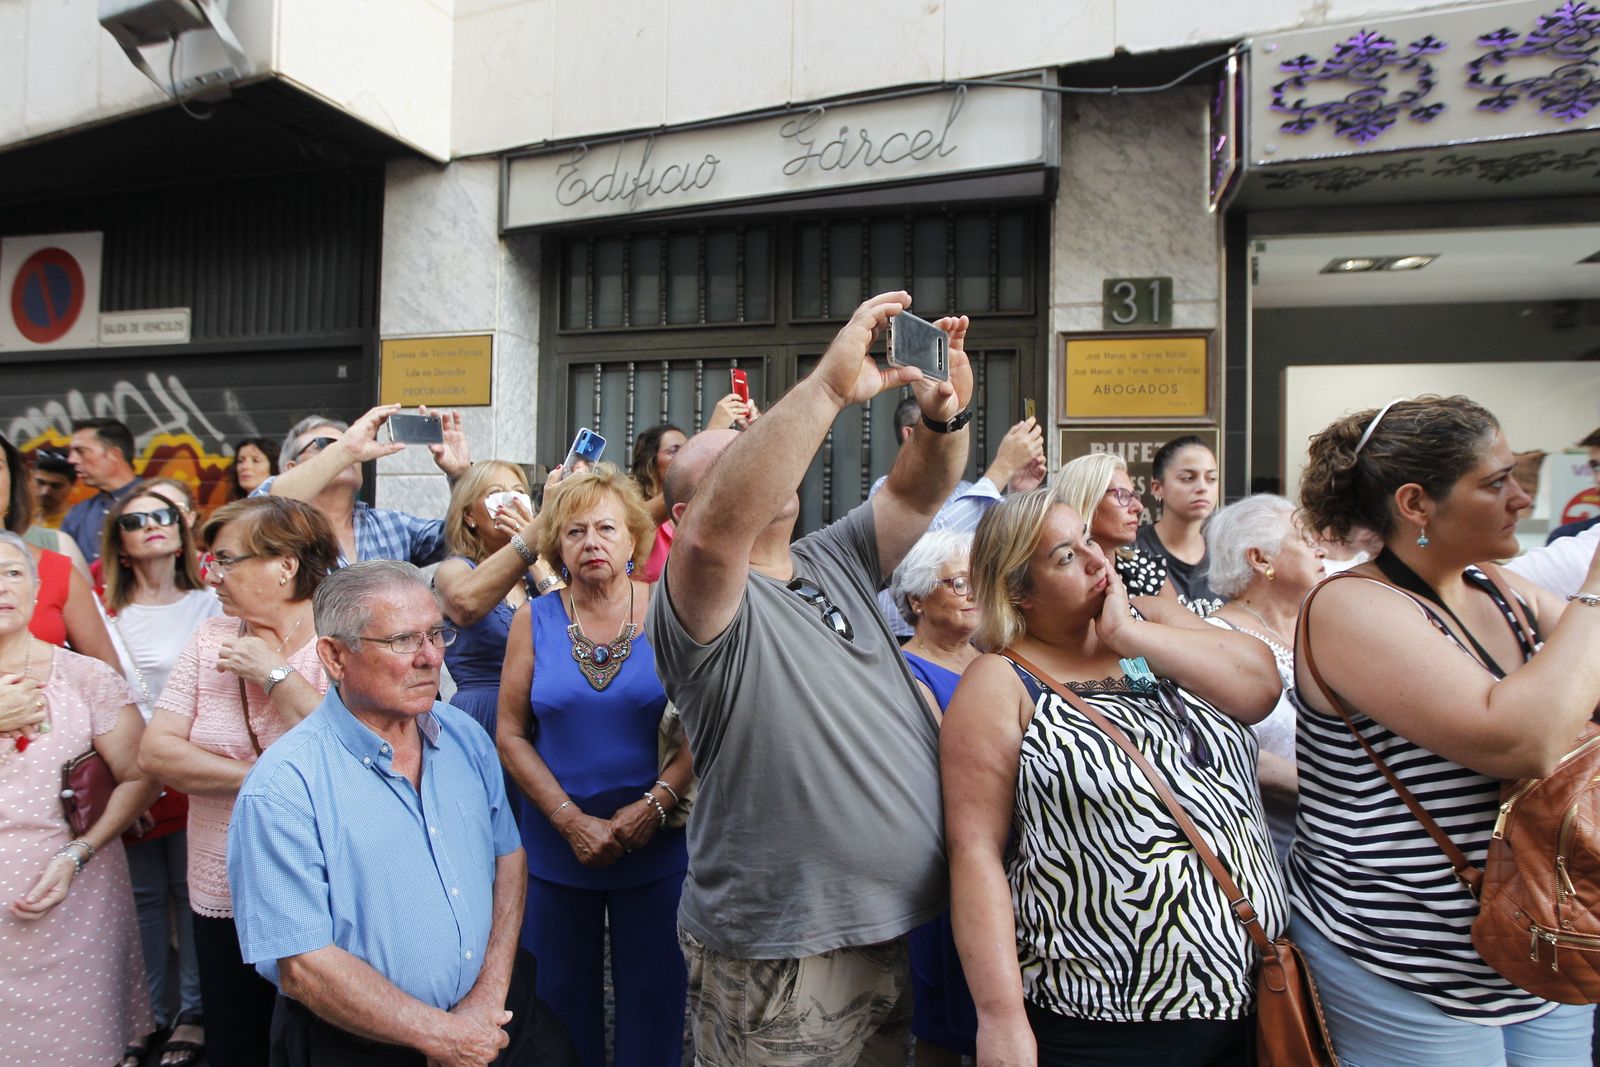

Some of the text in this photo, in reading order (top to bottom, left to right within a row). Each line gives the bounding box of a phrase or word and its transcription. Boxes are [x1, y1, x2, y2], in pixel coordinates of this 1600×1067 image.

[1112, 280, 1160, 323] 31
[420, 350, 429, 358] de
[1104, 351, 1127, 360] Manuel
[1130, 351, 1138, 359] de
[1142, 350, 1163, 359] Torres
[1091, 367, 1113, 376] Manuel
[1116, 367, 1124, 375] de
[1128, 367, 1149, 375] Torres
[1094, 383, 1178, 395] ABOGADOS
